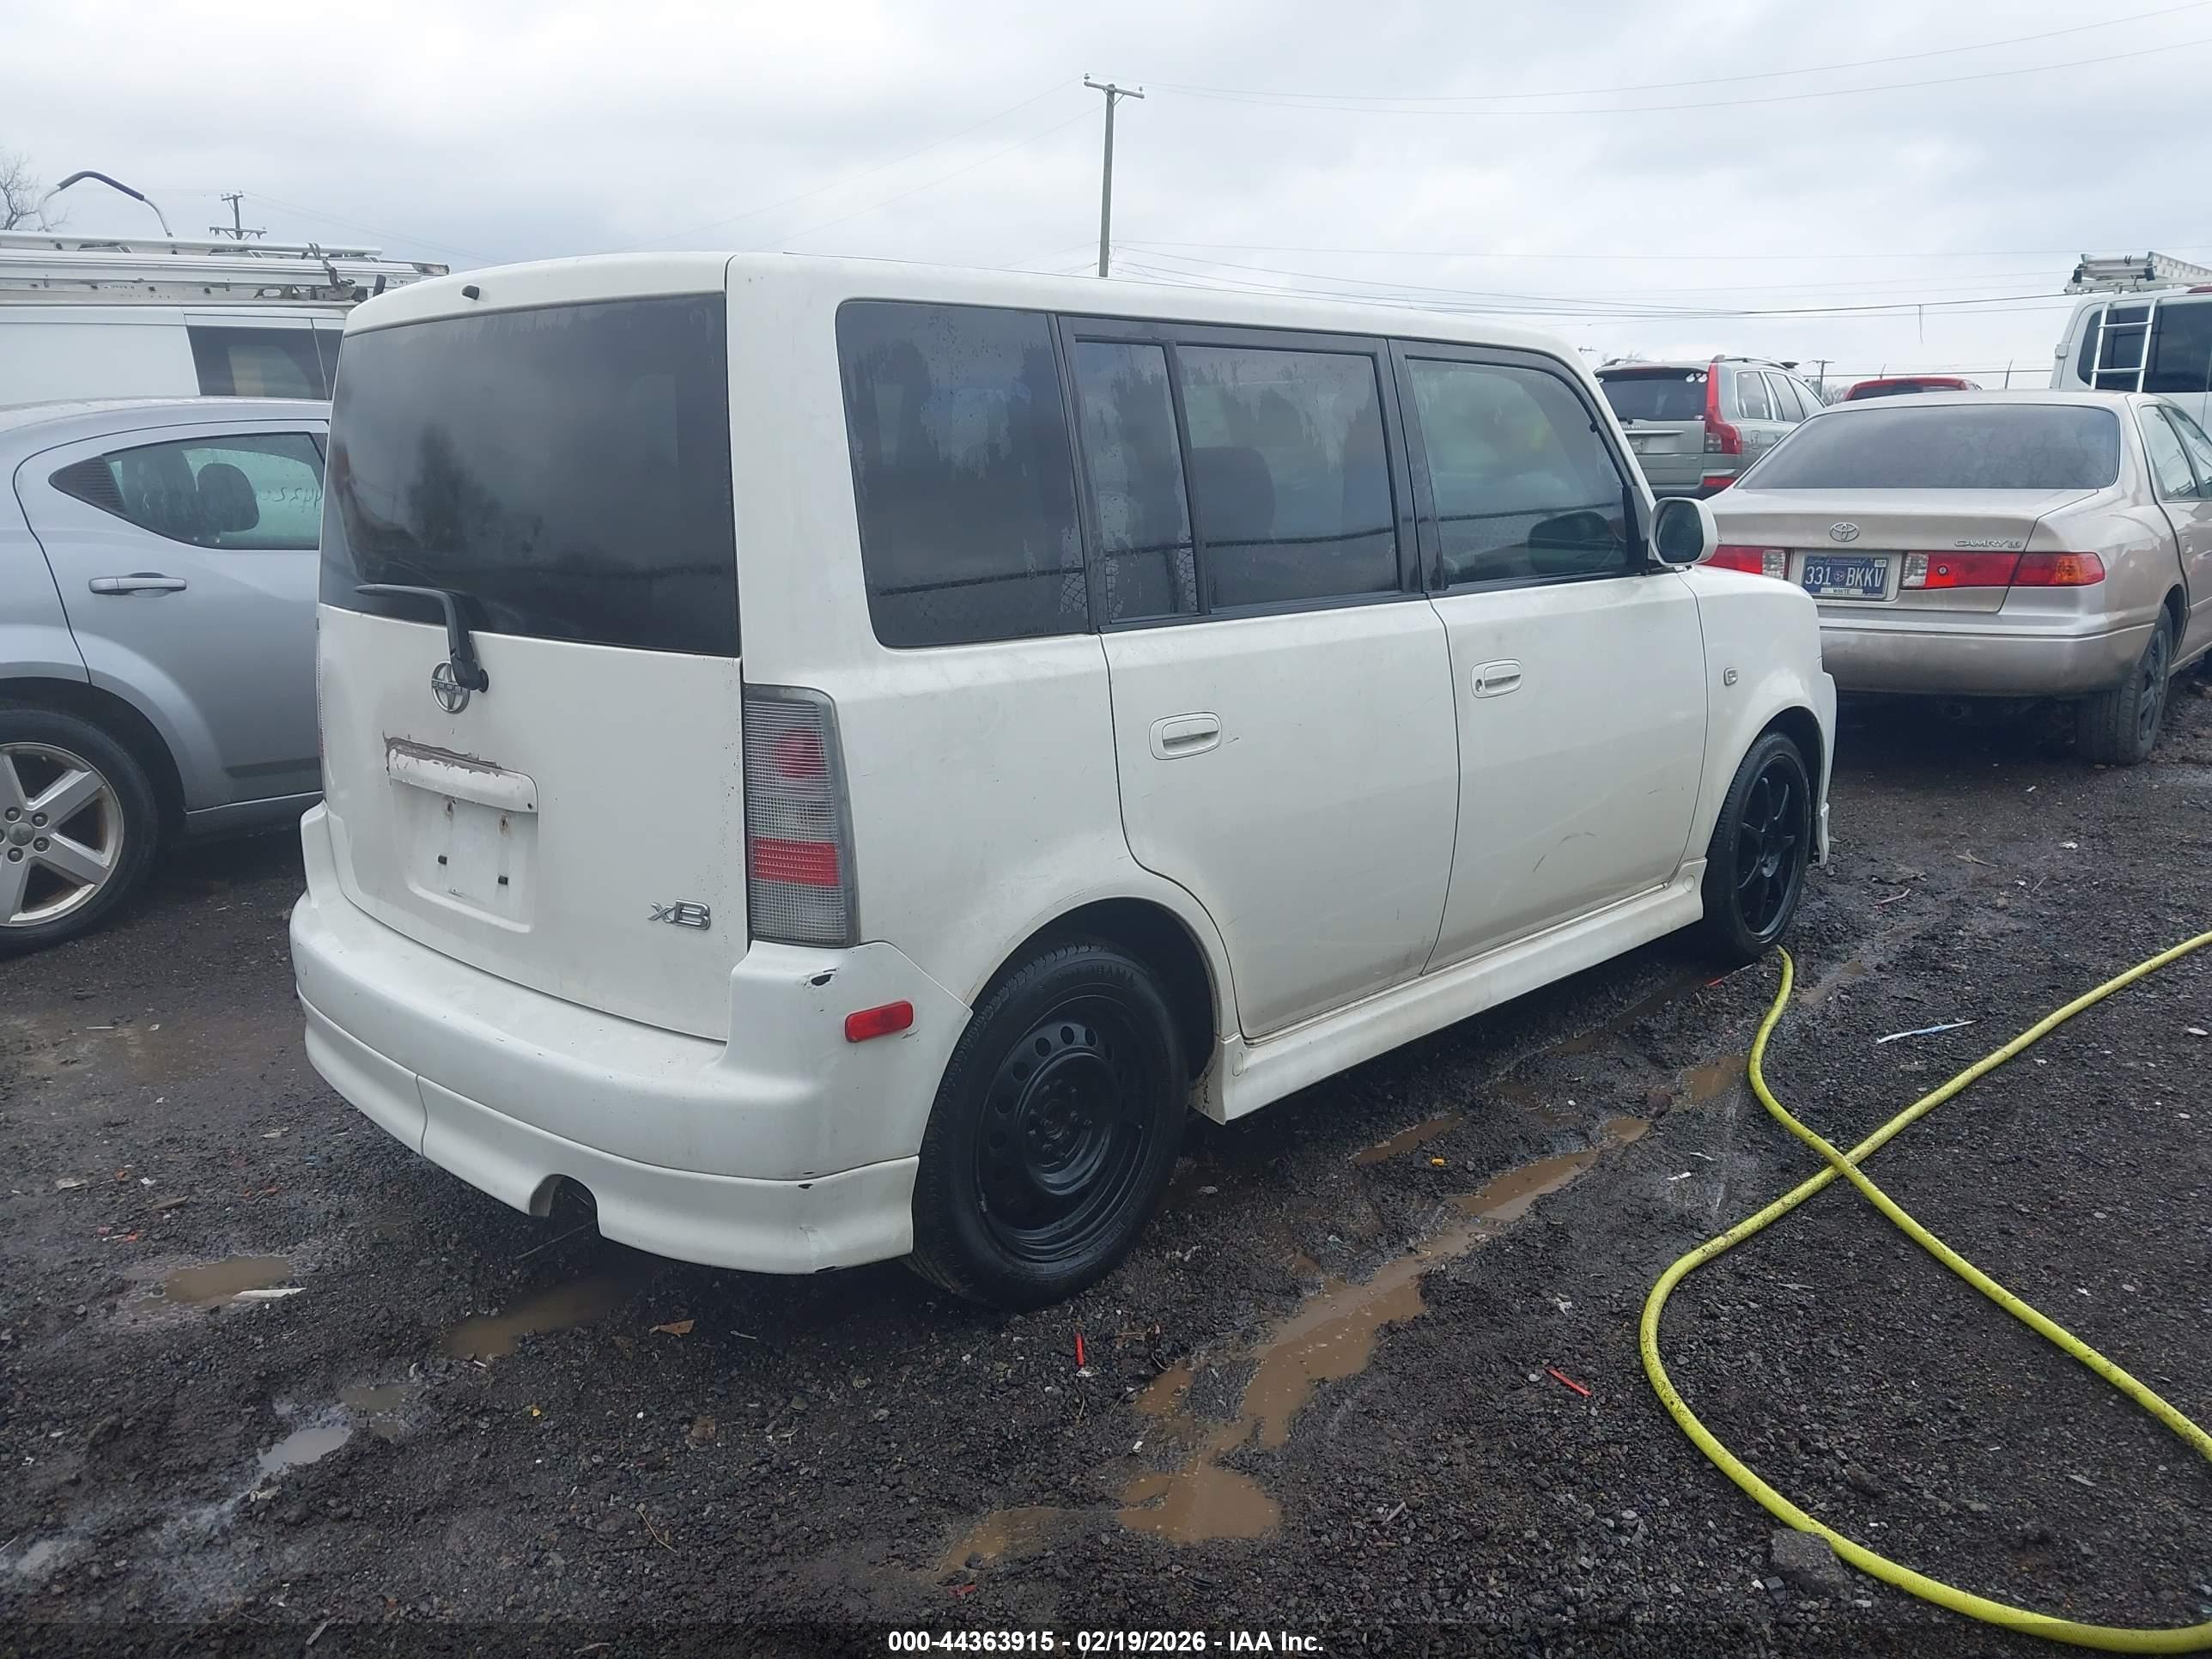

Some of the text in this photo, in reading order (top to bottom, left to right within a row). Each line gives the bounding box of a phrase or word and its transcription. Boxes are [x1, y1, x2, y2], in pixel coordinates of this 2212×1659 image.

[1954, 538, 2008, 548] CAMRY
[1805, 566, 1885, 587] 331 BKKV
[647, 898, 711, 930] xB
